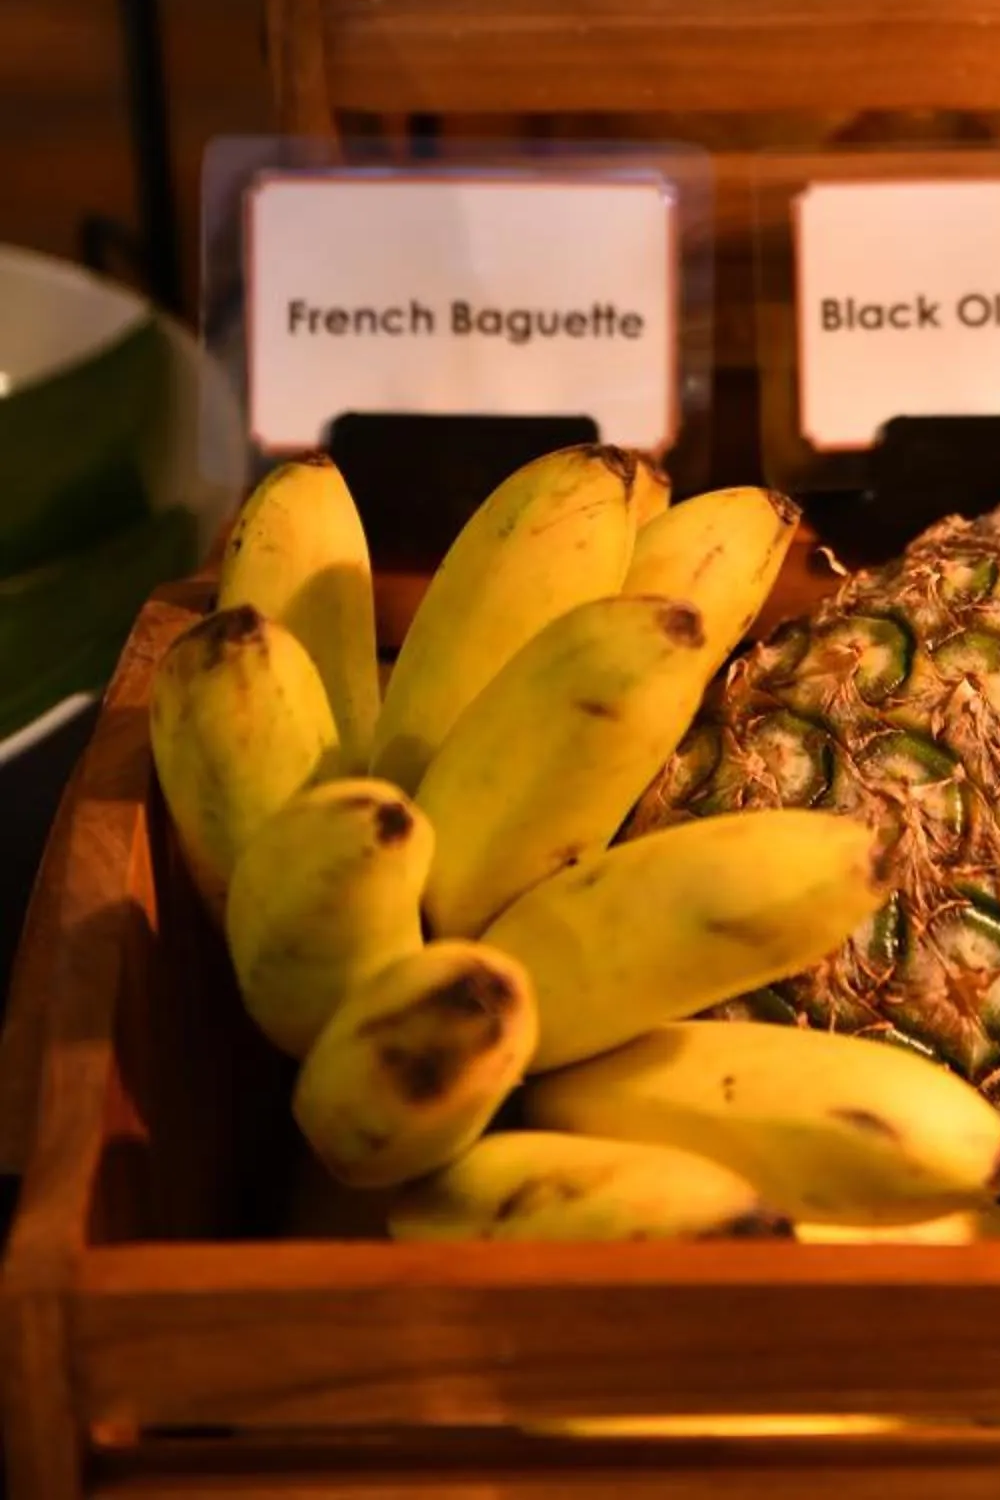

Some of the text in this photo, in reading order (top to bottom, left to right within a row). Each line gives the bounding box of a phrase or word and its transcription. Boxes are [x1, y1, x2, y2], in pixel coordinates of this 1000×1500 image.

[287, 299, 645, 345] French Baguette
[820, 296, 941, 331] Black
